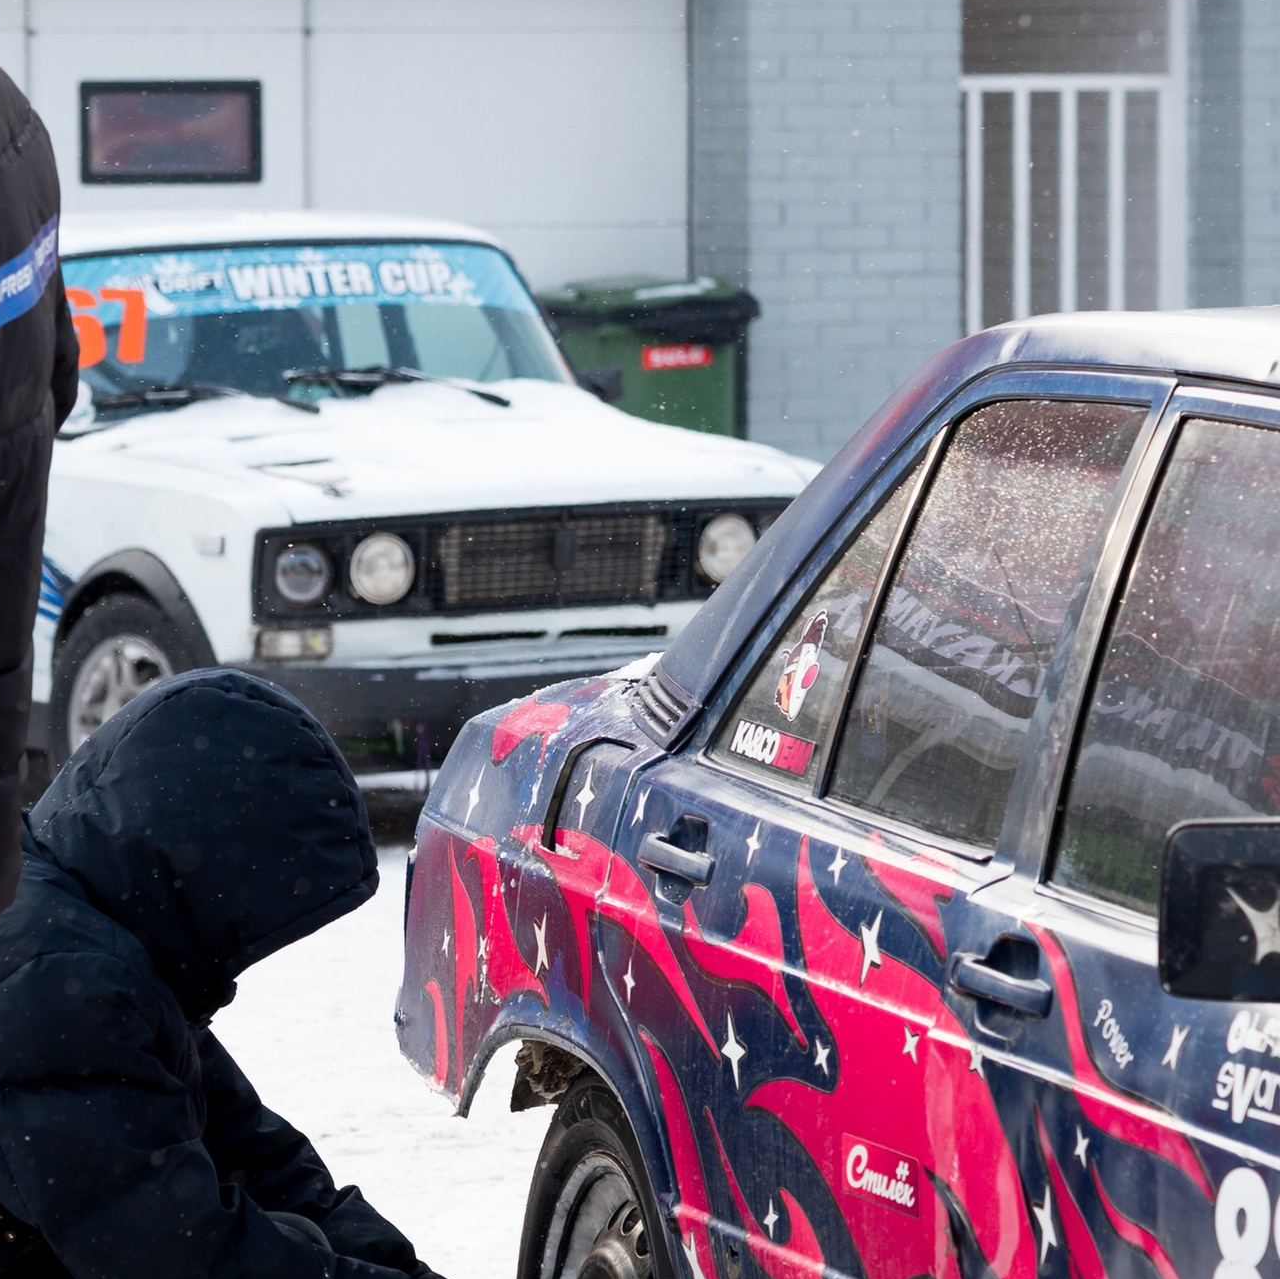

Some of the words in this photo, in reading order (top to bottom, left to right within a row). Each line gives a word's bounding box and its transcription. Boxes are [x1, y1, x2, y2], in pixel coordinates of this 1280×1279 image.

[227, 260, 376, 301] WINTER
[377, 259, 452, 297] CUP
[1093, 999, 1134, 1070] Power
